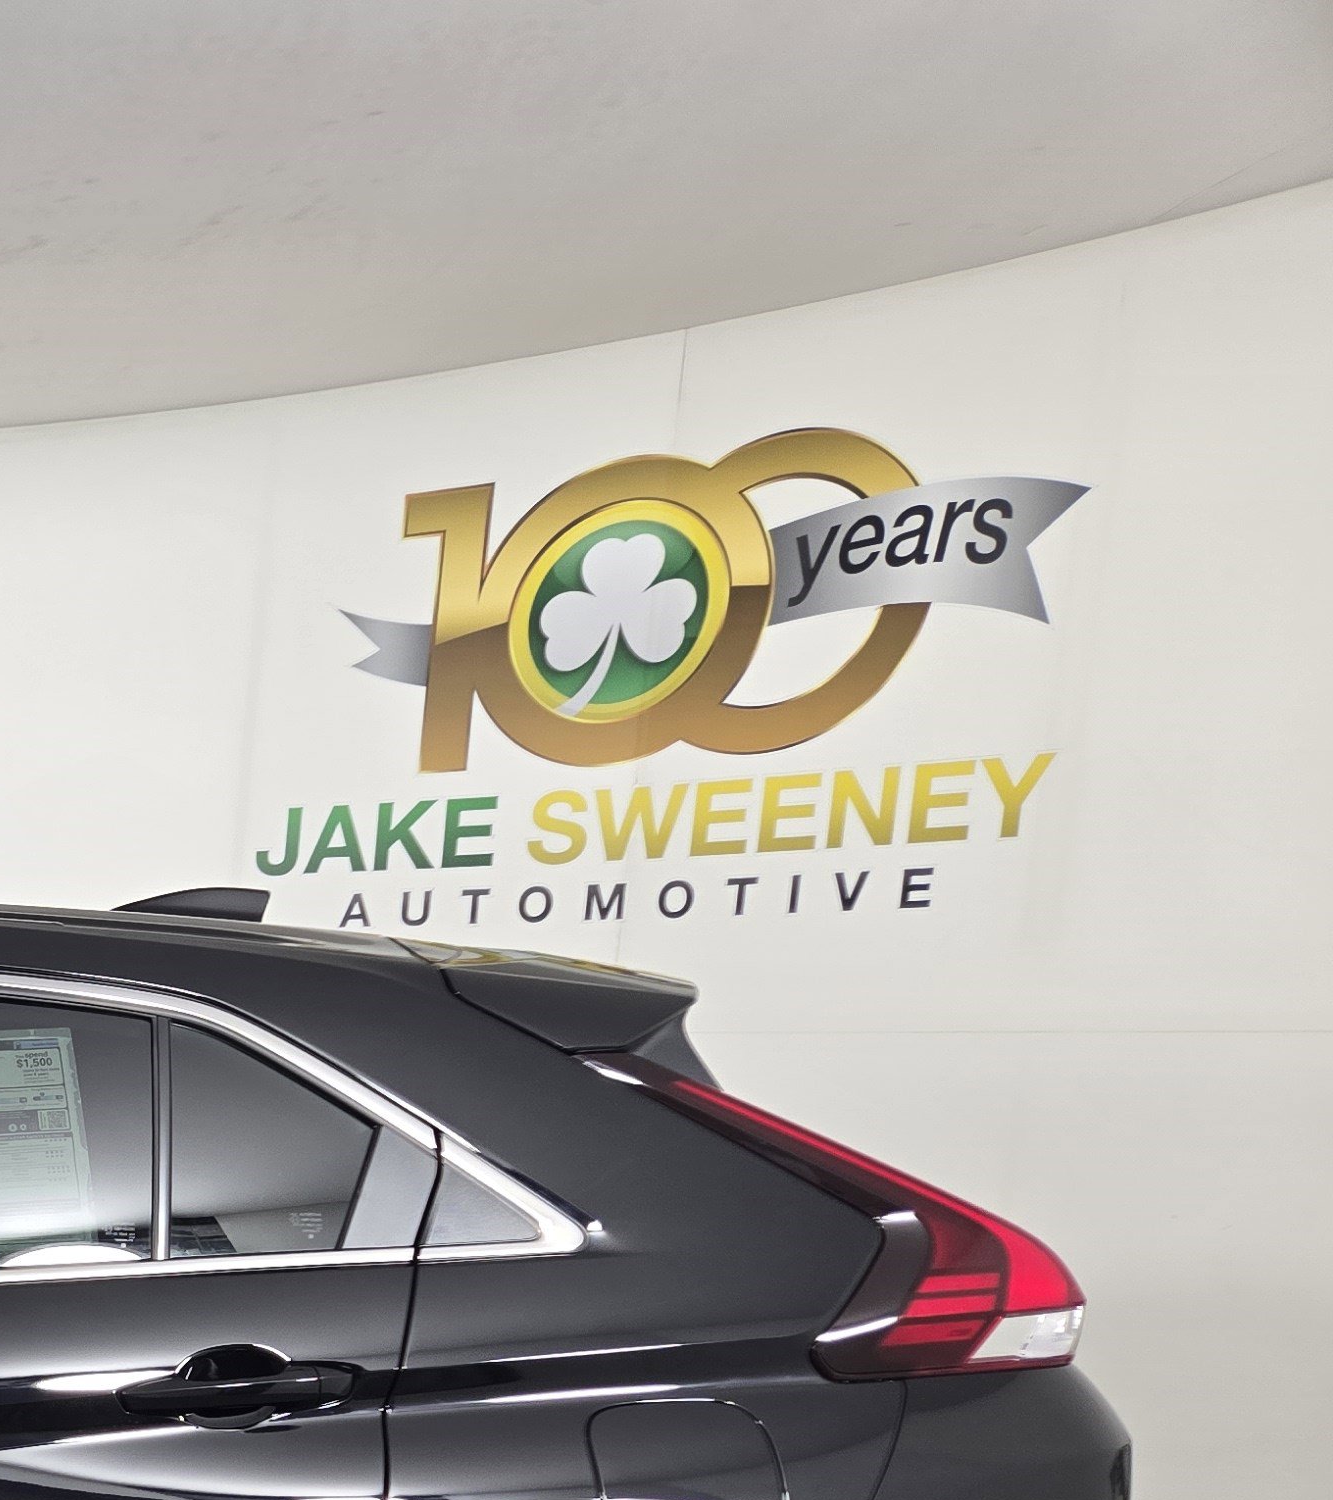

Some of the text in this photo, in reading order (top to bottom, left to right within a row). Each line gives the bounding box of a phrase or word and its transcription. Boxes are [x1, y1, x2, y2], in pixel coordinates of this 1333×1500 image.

[403, 427, 1014, 774] 100 years
[255, 751, 1056, 877] JAKE SWEENEY
[339, 868, 935, 930] AUTOMOTIVE
[16, 1057, 53, 1068] $1,500
